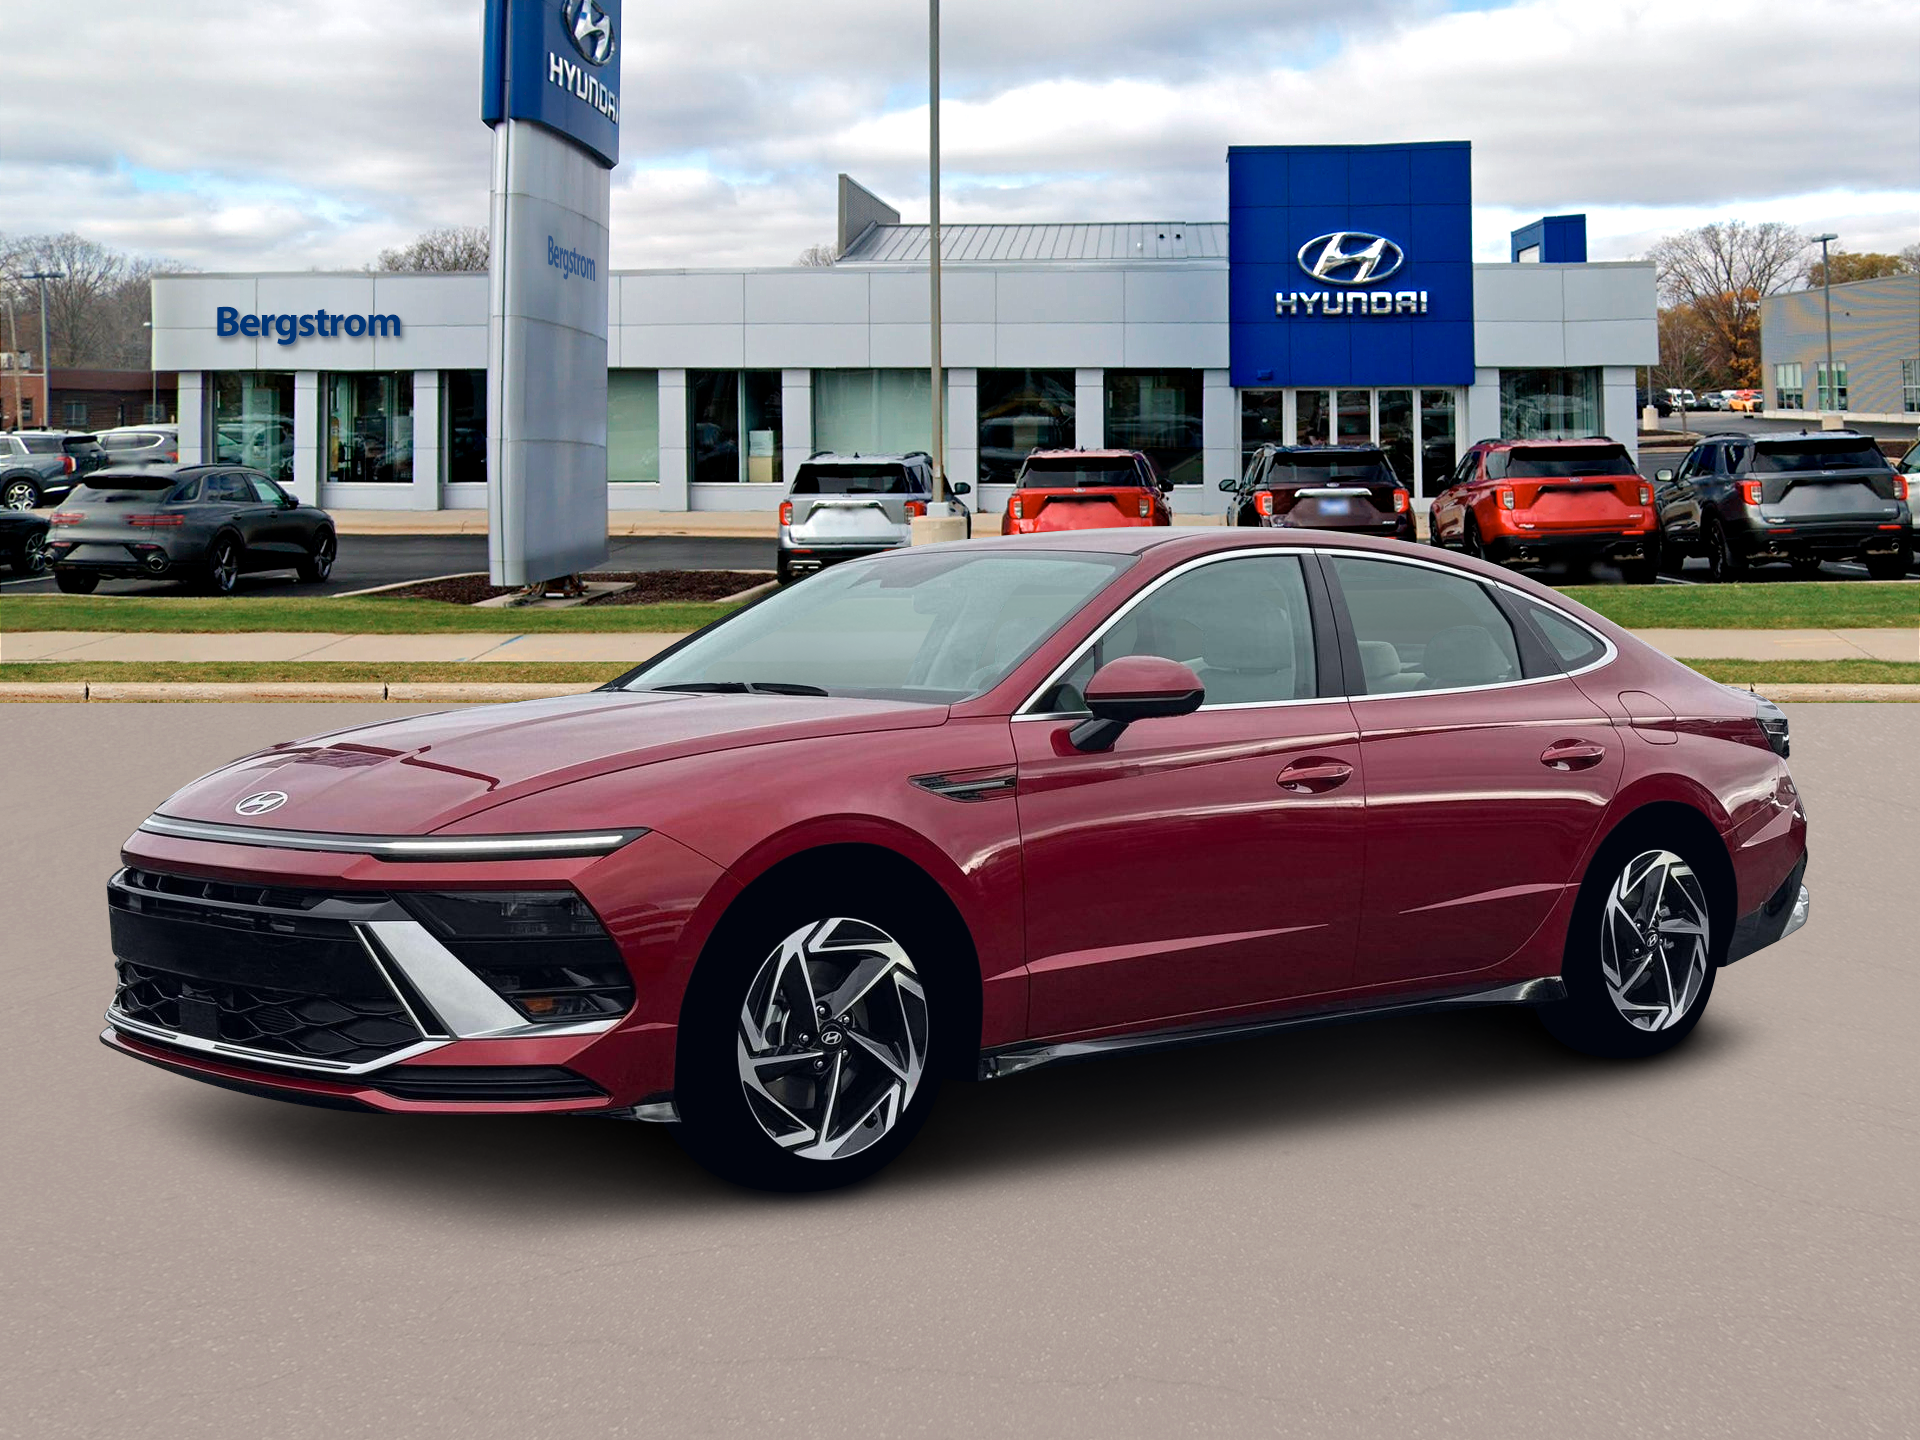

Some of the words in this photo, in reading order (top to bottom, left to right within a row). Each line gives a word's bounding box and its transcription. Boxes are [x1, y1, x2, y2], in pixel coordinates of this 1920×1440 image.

[549, 52, 618, 124] HYUNDAI
[547, 235, 596, 282] Bergstrom
[1275, 290, 1428, 315] HYUNDAI
[216, 306, 401, 346] Bergstrom
